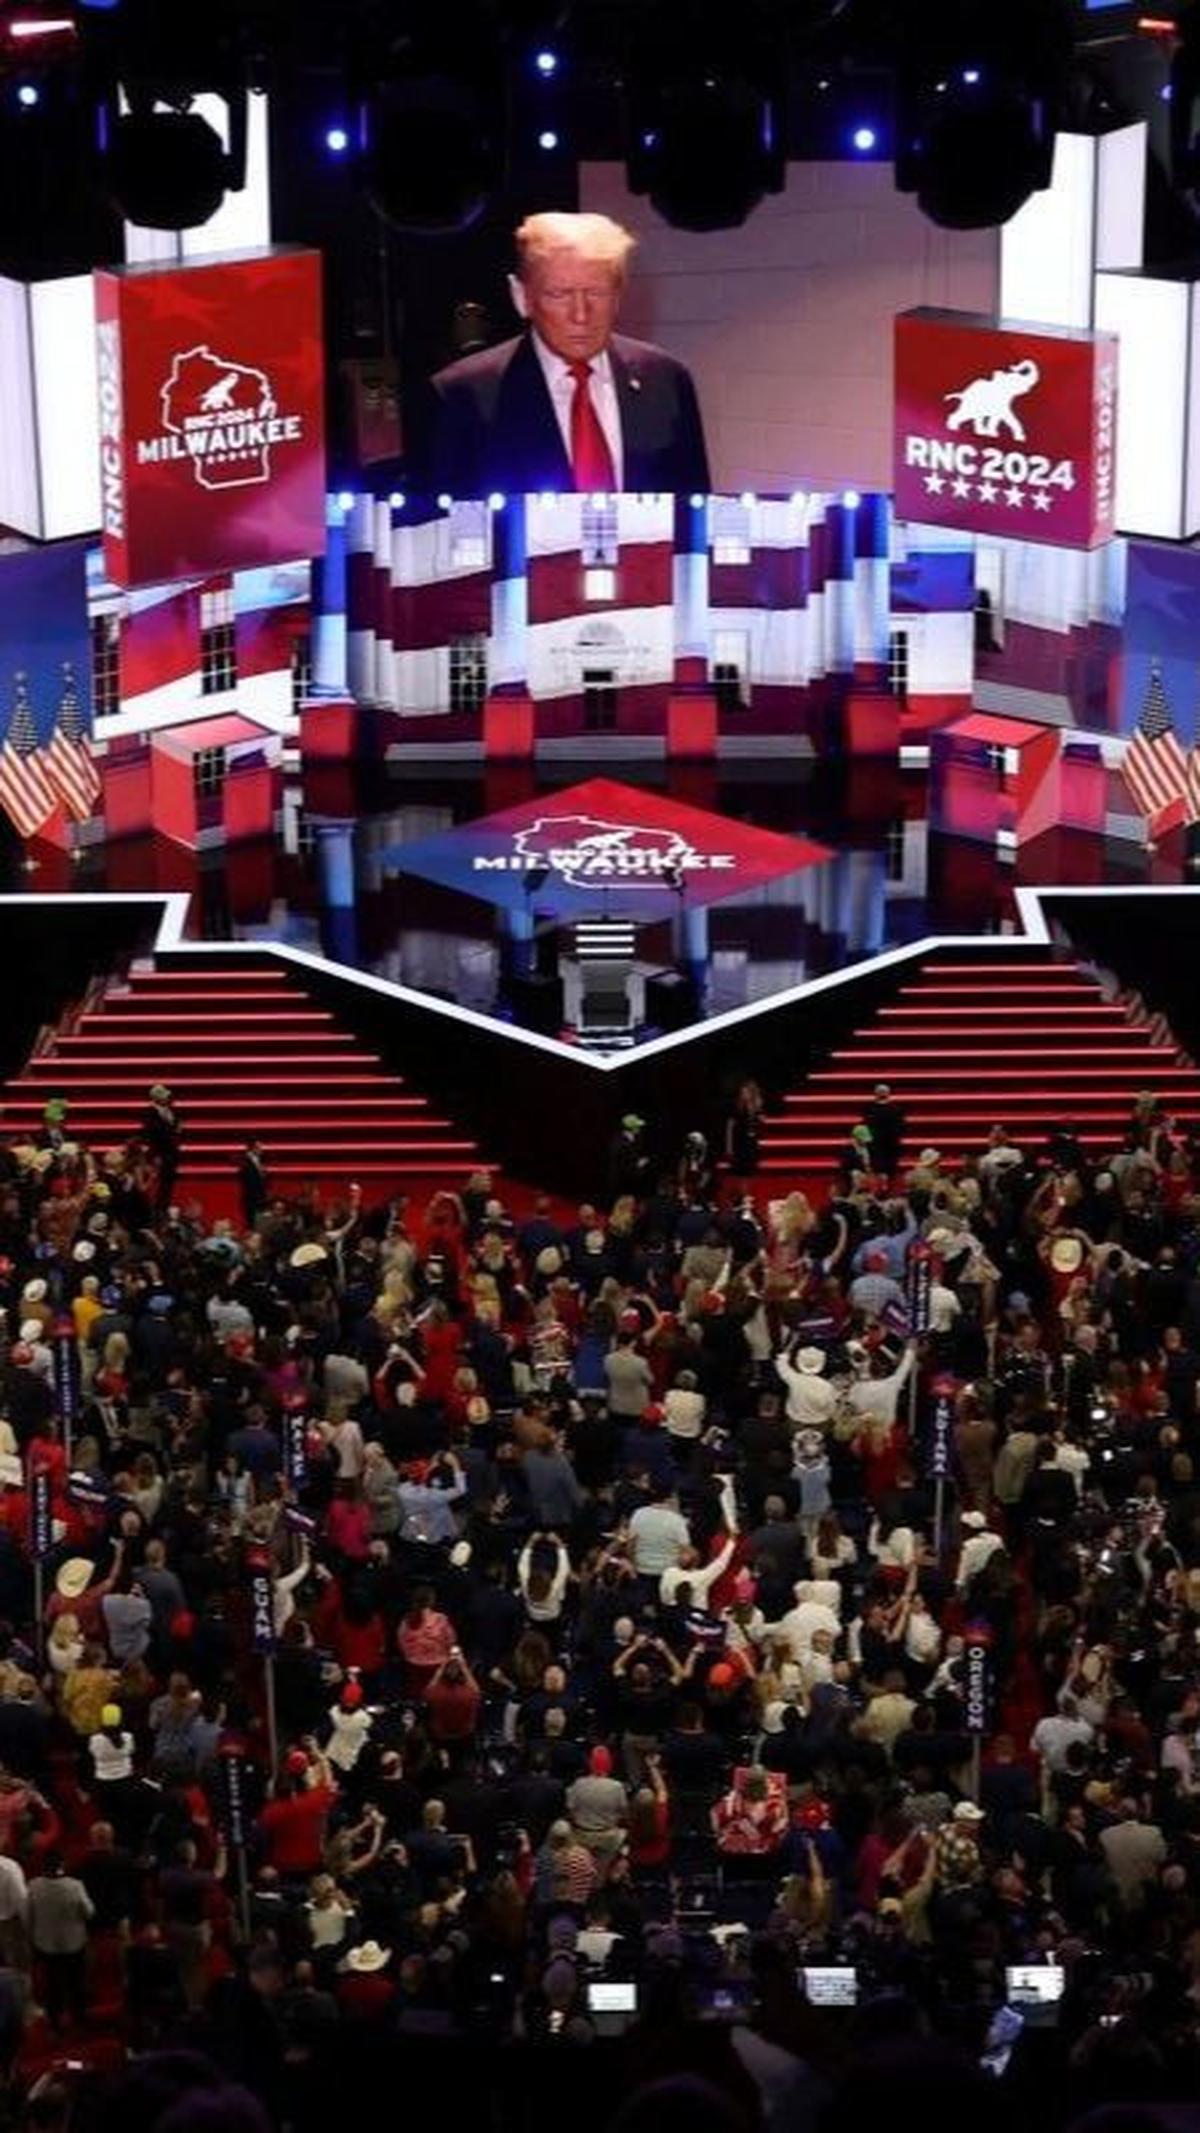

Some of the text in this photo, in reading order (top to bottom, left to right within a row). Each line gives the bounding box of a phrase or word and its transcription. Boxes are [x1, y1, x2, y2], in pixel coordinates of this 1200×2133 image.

[136, 416, 302, 464] MILWAUKEE
[906, 435, 1076, 492] RNC 2024
[103, 444, 124, 539] RNC
[472, 854, 739, 870] MILWAUKEE
[933, 1398, 950, 1473] INDIANA
[253, 1577, 271, 1639] GUAM
